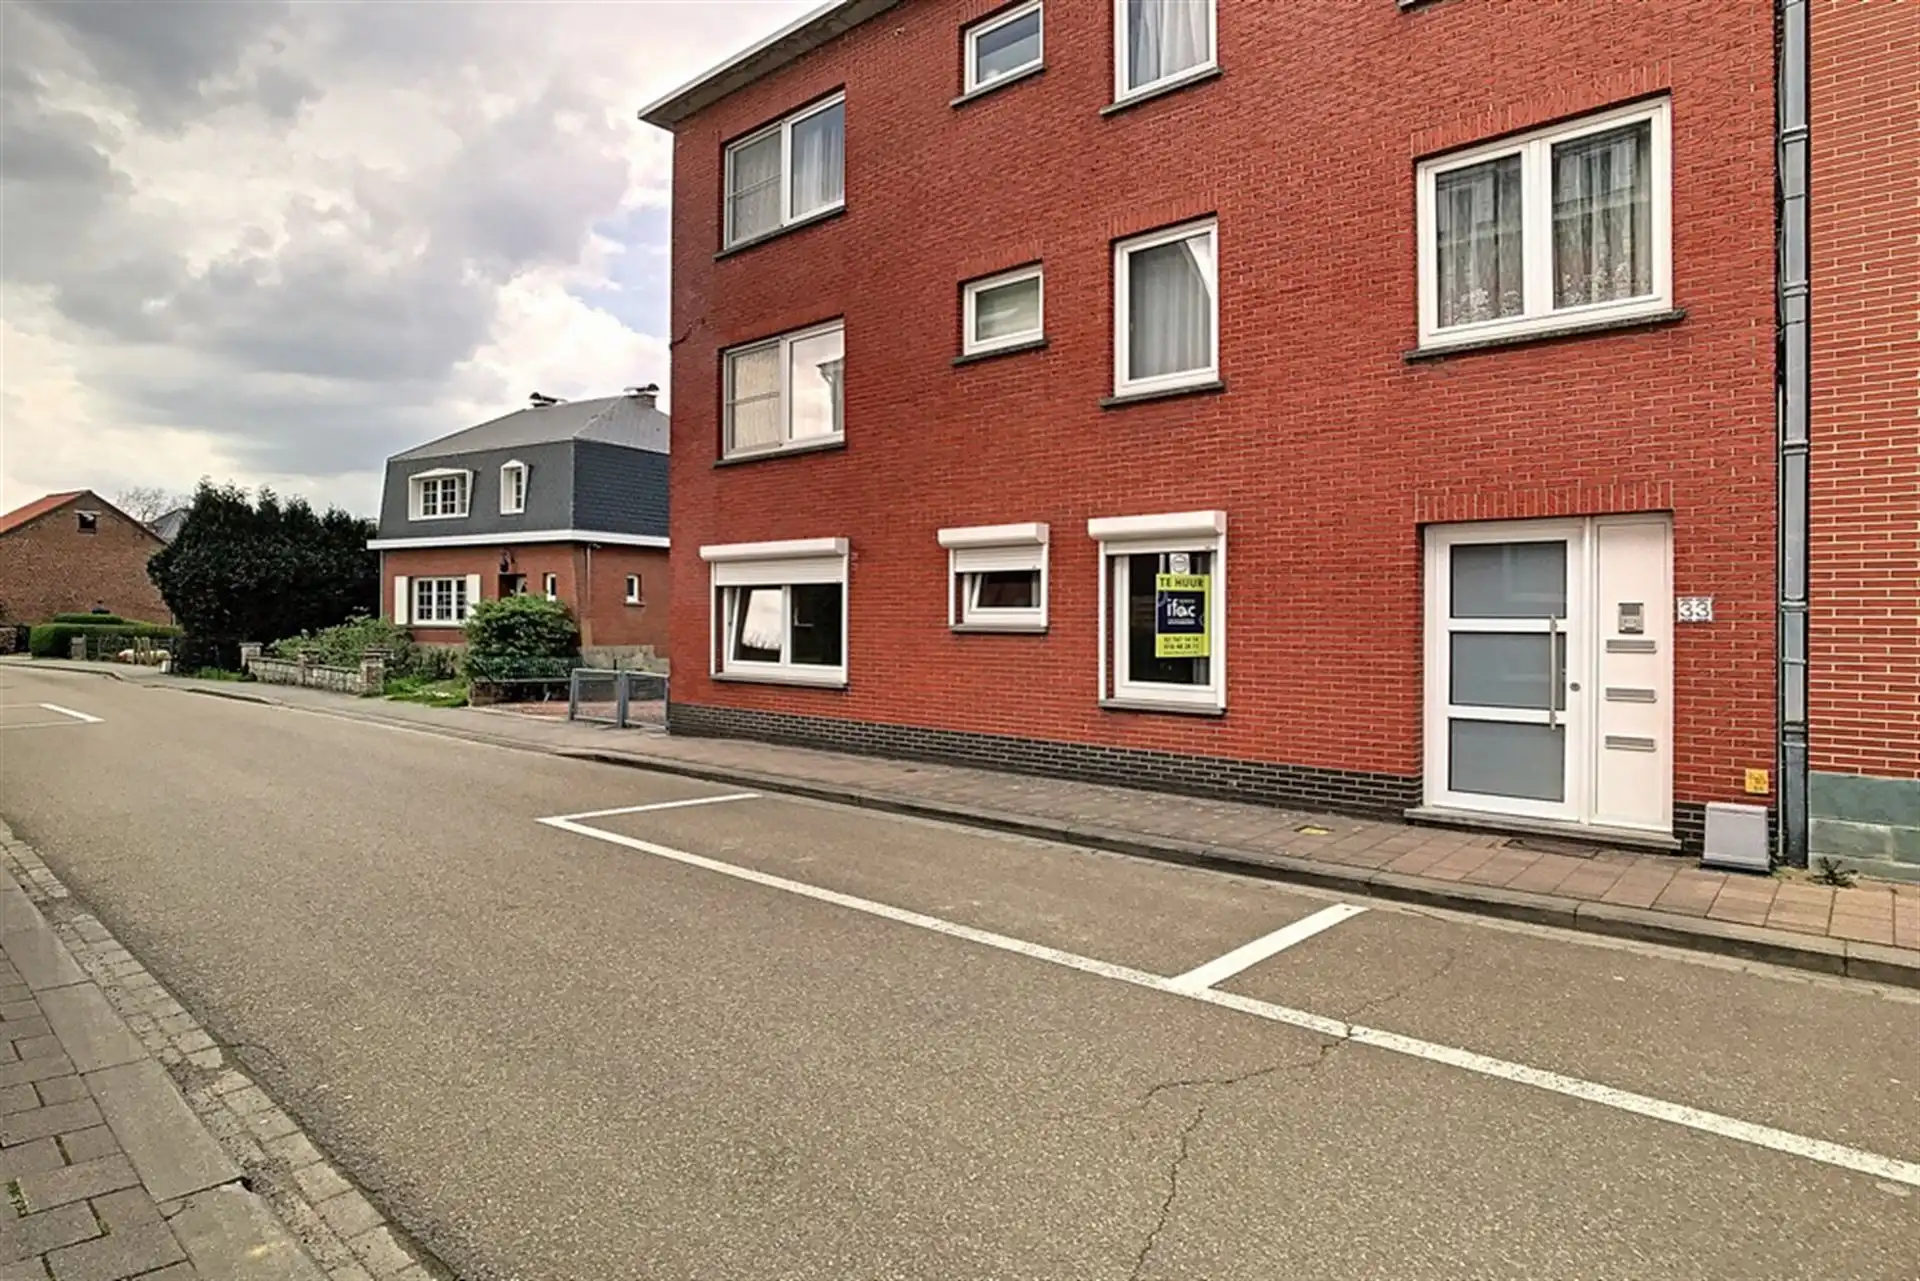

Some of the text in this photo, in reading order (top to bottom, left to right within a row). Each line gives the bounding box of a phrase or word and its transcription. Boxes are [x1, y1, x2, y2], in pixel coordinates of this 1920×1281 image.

[1160, 577, 1204, 588] TE HUUR
[1166, 598, 1196, 617] ifac
[1680, 601, 1710, 617] 33
